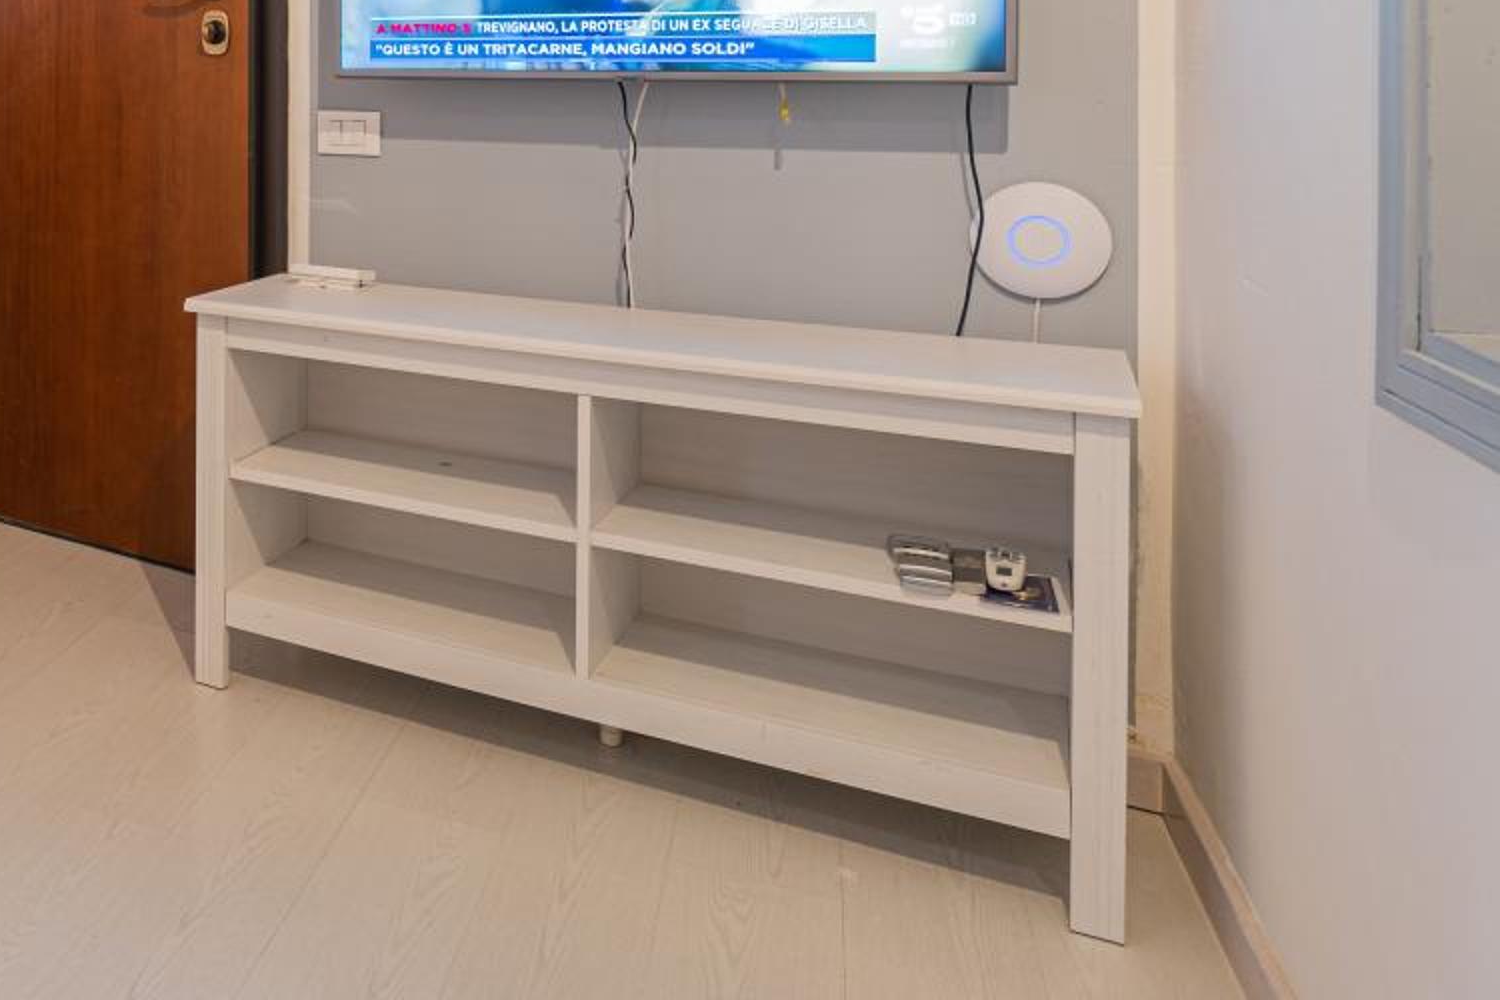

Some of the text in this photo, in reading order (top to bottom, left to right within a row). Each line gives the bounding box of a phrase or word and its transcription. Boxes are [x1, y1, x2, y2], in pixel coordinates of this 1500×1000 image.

[477, 20, 559, 34] TREVIGNANO,
[561, 20, 579, 33] LA
[581, 20, 649, 33] PROTESTA
[651, 19, 666, 32] DI
[669, 19, 690, 32] UN
[692, 19, 712, 32] EX
[801, 17, 868, 32] GISELLA
[443, 40, 453, 56] È
[457, 42, 479, 56] UN
[483, 42, 588, 57] TRITACARNE,
[591, 42, 687, 56] MANGIANO
